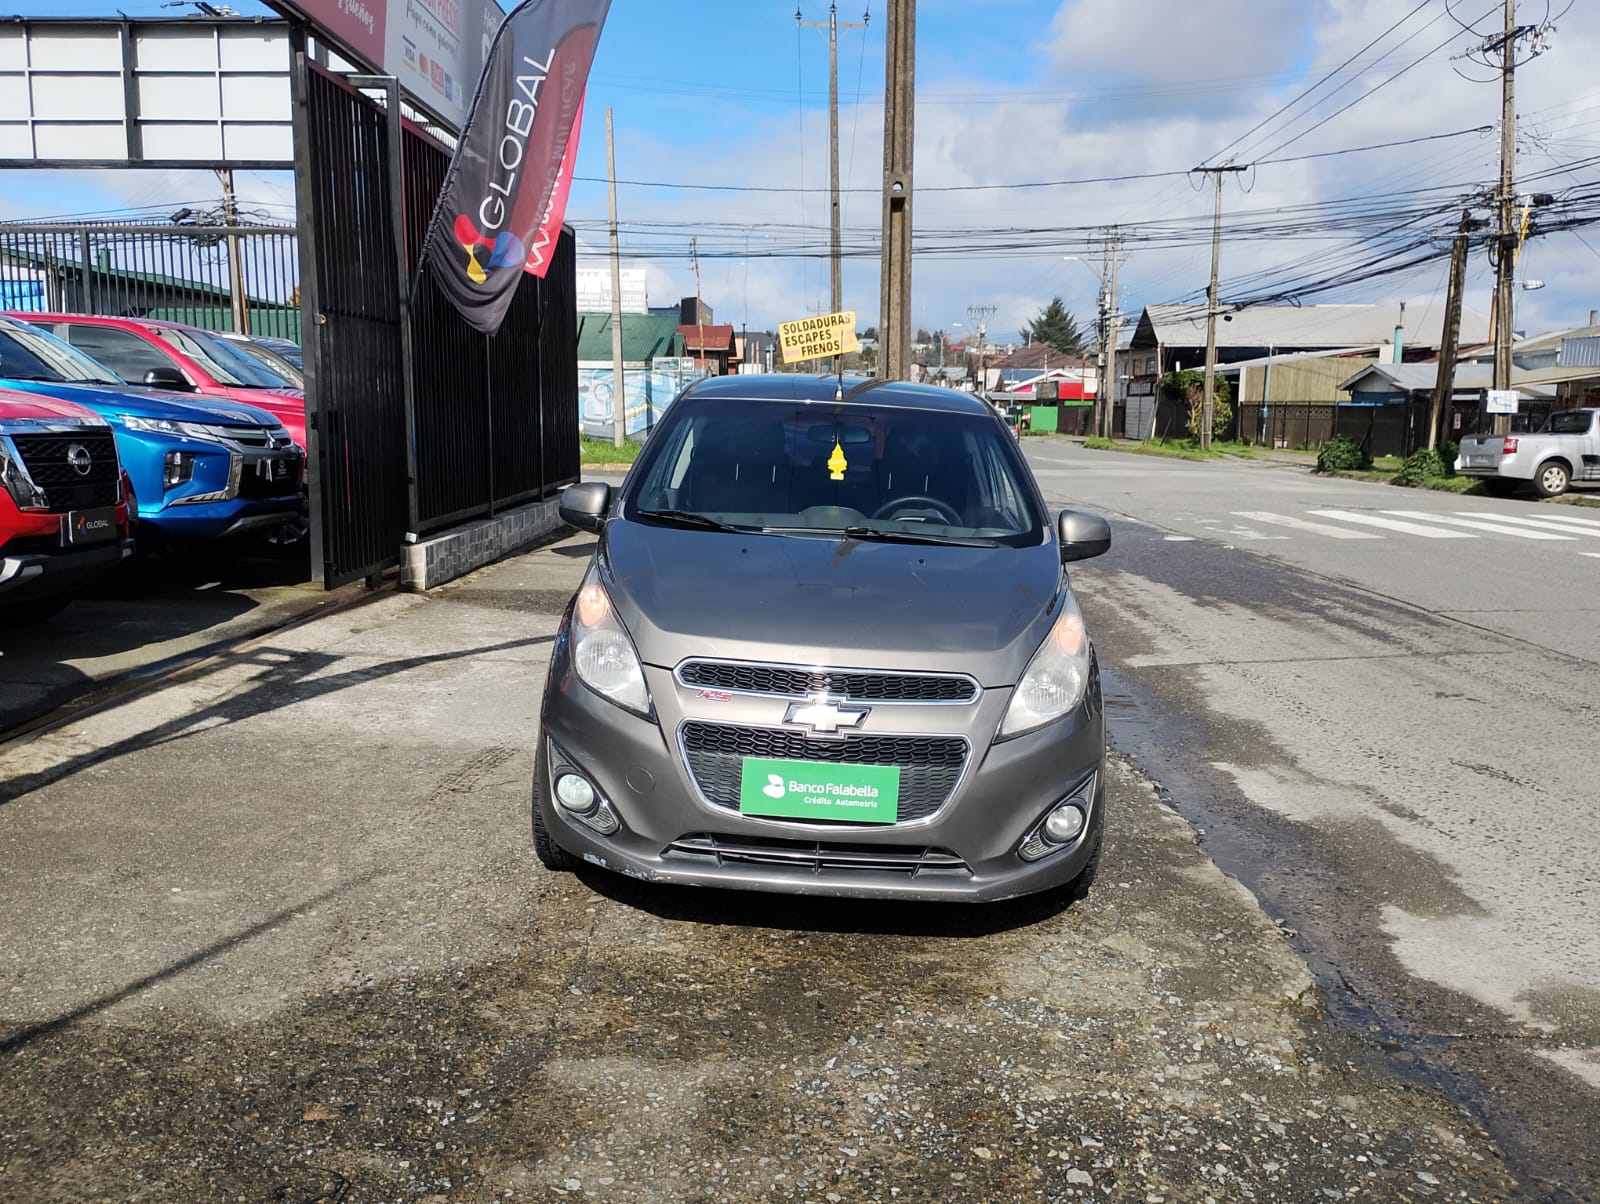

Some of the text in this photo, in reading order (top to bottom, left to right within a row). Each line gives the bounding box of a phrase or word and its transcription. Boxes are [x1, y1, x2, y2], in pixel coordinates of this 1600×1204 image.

[479, 48, 556, 230] GLOBAL
[783, 313, 851, 335] SOLDADURAS
[785, 329, 832, 347] ESCAPES
[801, 340, 840, 357] FRENOS
[86, 519, 110, 529] GLOBAL
[788, 780, 879, 797] Banco Falabella
[804, 796, 878, 808] Crédito Automotriz
